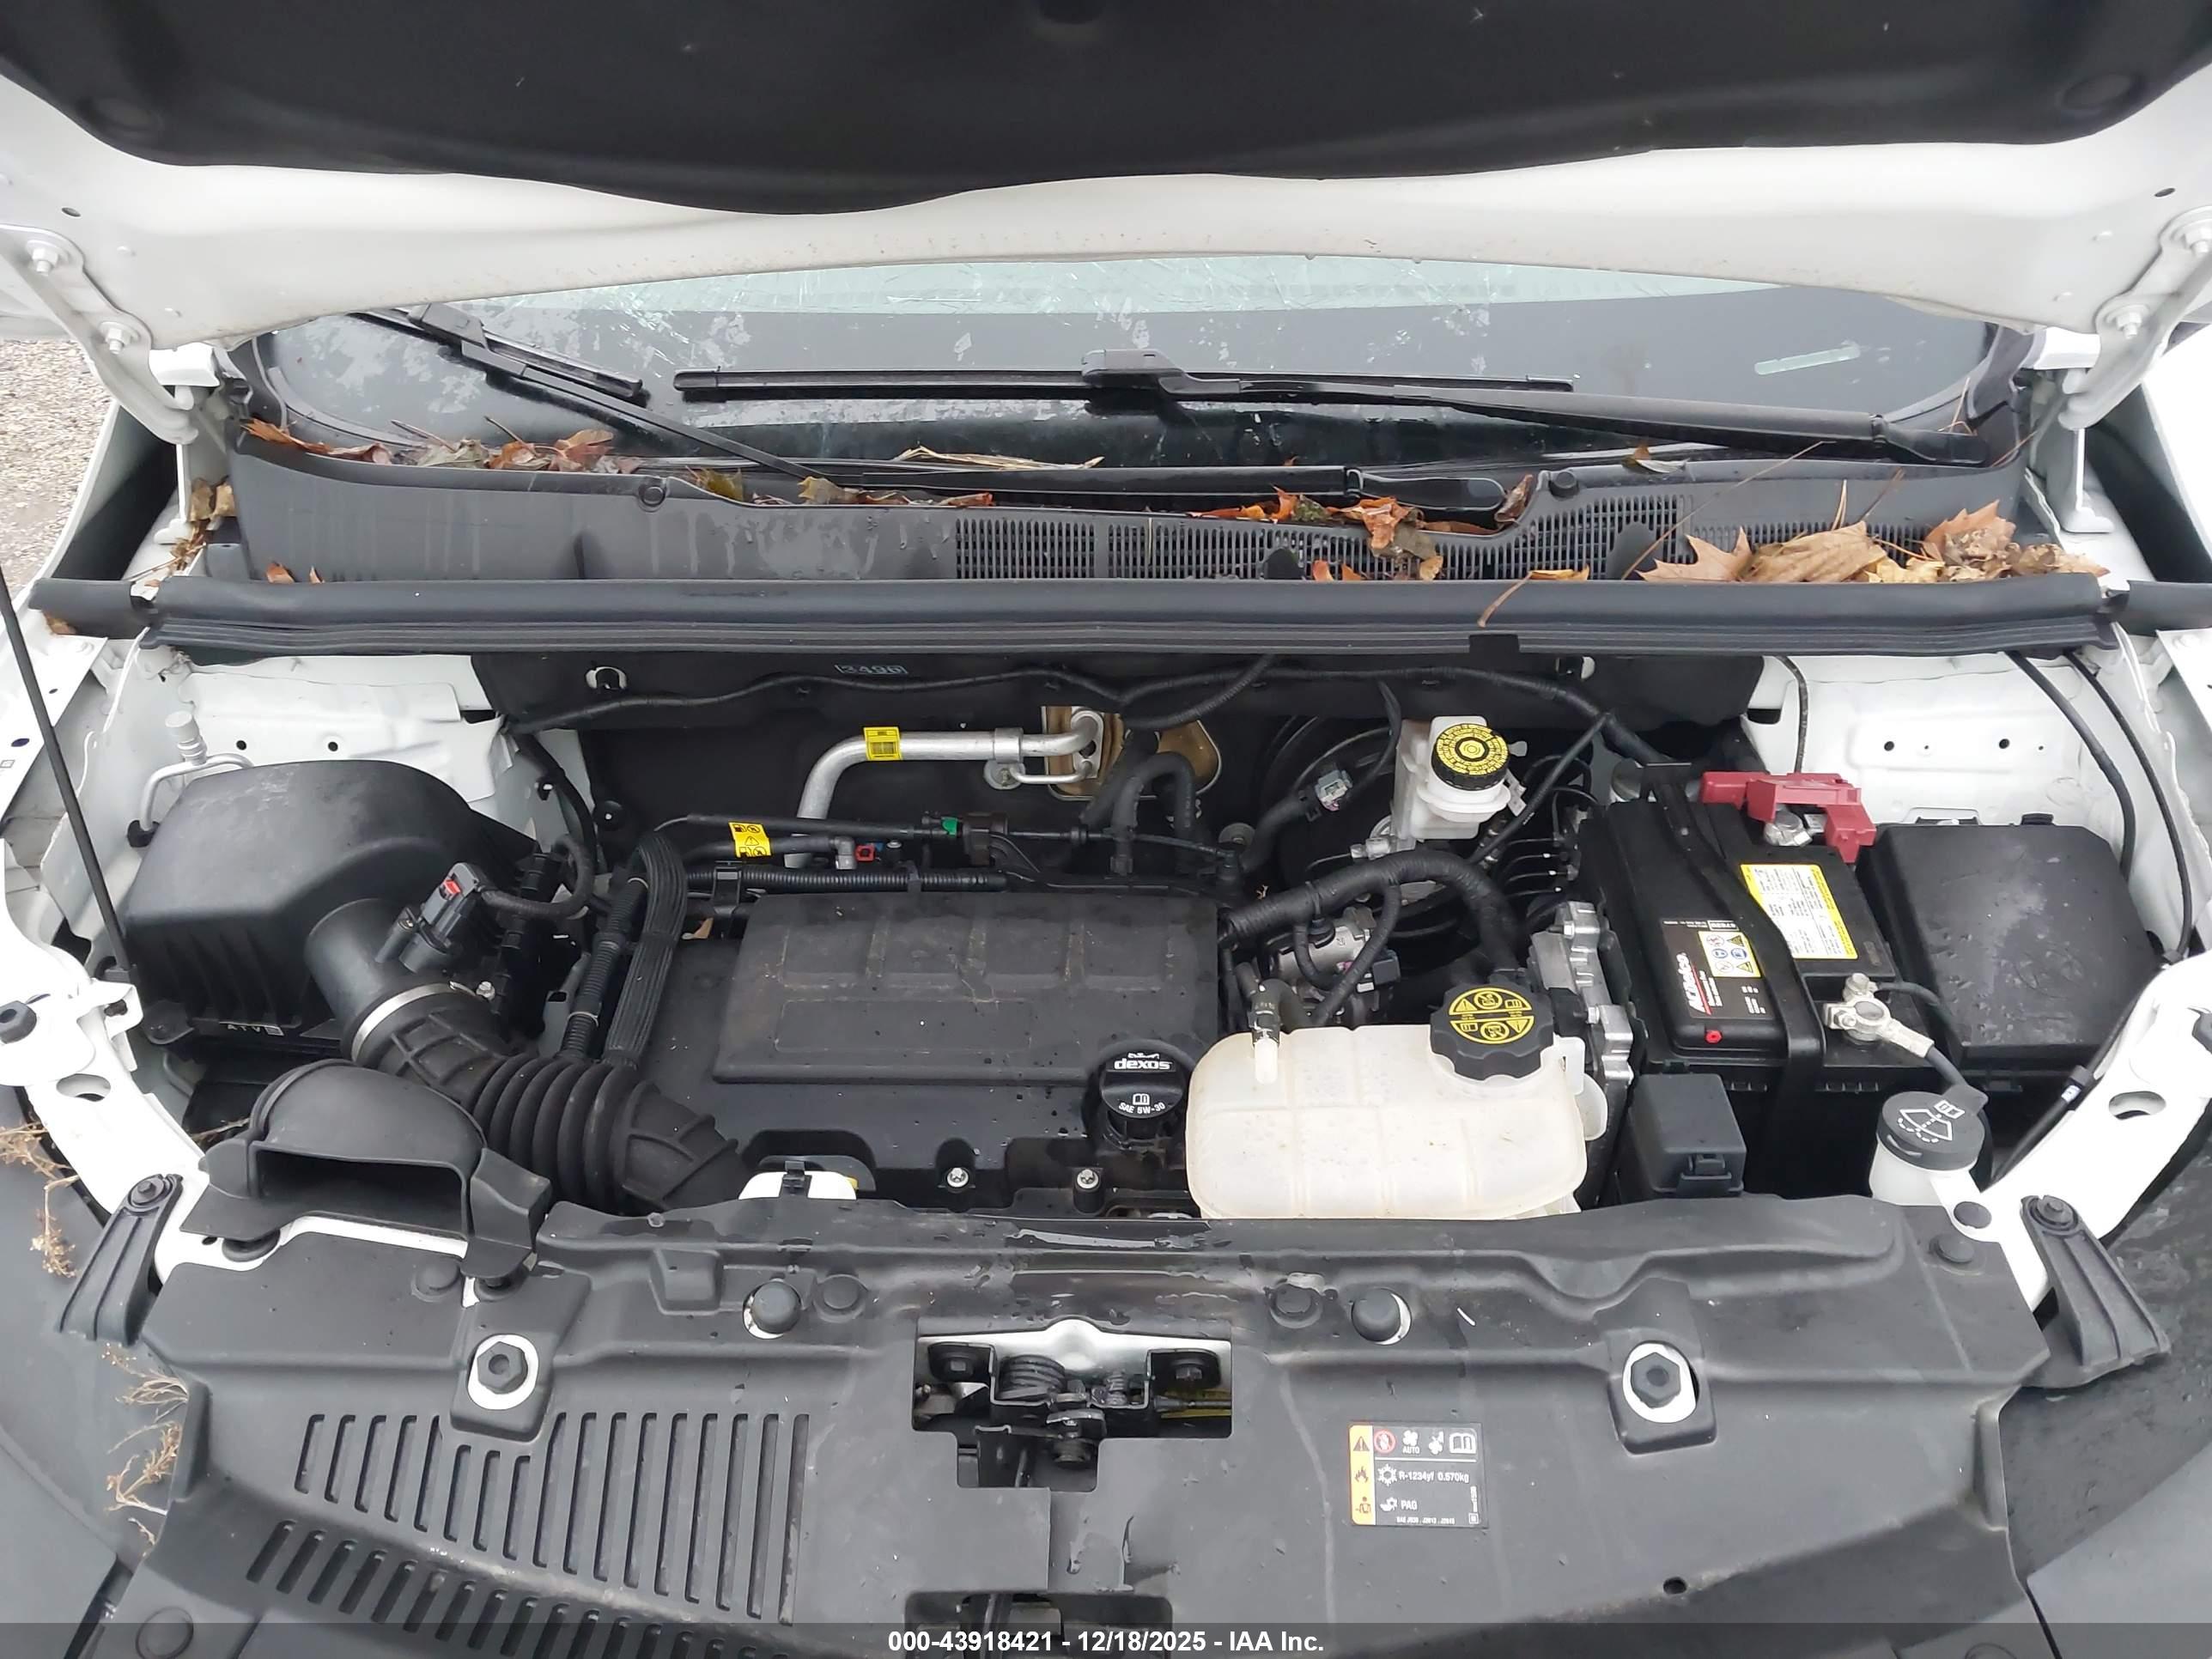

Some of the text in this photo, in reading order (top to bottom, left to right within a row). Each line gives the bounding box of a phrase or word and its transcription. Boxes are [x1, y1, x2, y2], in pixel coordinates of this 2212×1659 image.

[1676, 953, 1705, 1012] ACDelco
[1114, 1058, 1172, 1070] dexos
[1119, 1102, 1165, 1114] SAE 5W-30
[1399, 1471, 1469, 1483] R-1234yf 0.570kg
[1401, 1499, 1418, 1510] PAG
